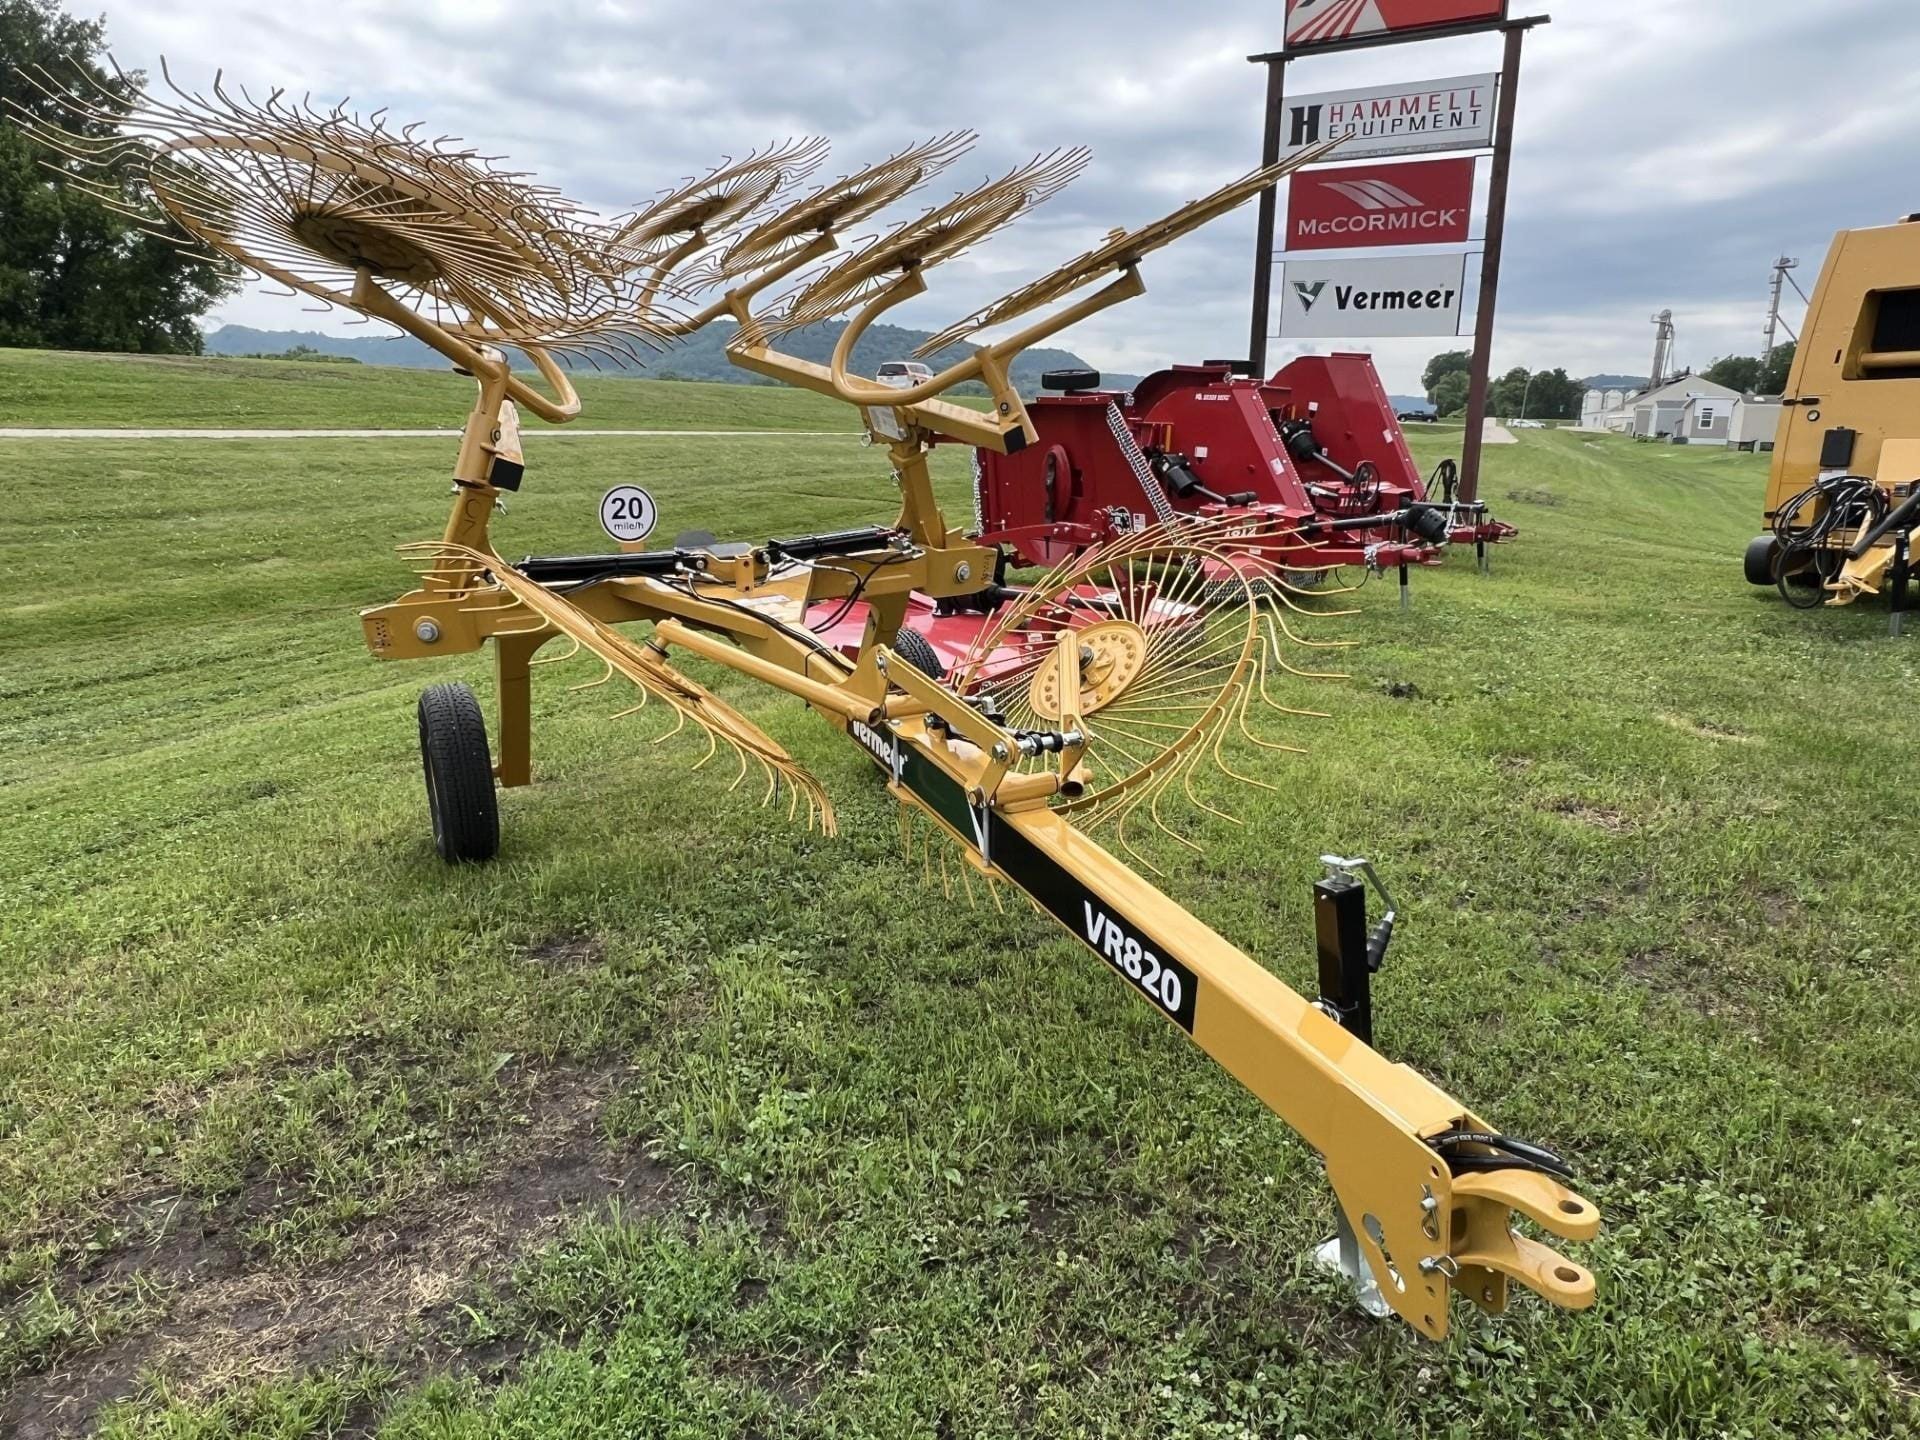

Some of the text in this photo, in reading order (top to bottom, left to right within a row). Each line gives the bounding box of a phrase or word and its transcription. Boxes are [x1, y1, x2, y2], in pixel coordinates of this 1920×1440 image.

[1329, 90, 1482, 123] HAMMELL
[1328, 109, 1481, 140] EQUIPMENT
[1298, 209, 1457, 236] McCORMICK
[1335, 285, 1455, 310] Vermeer
[611, 497, 643, 520] 20
[614, 521, 644, 531] mile/h
[1084, 900, 1182, 1012] VR820
